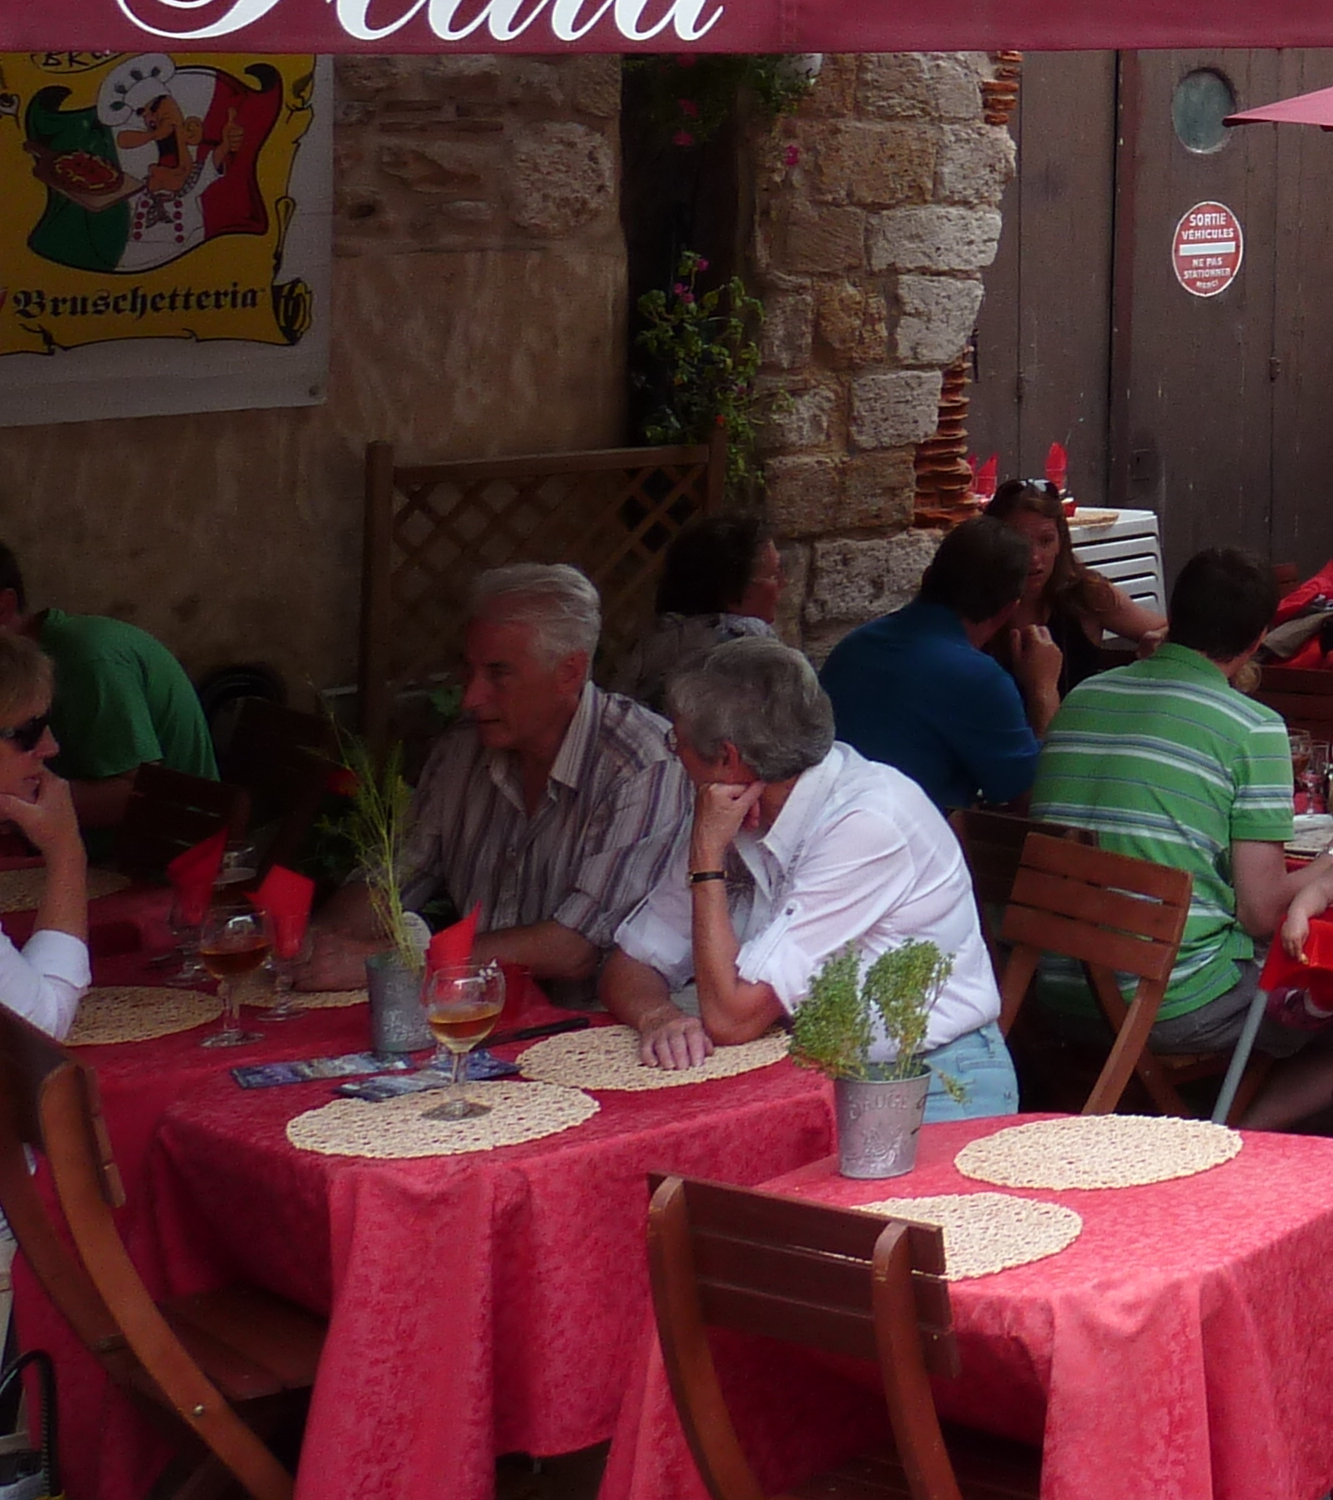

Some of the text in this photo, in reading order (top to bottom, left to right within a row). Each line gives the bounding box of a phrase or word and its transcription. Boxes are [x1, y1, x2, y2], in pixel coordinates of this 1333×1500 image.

[1189, 212, 1227, 227] SORTIE
[1181, 228, 1234, 241] VÉHICULES
[1192, 257, 1223, 268] NE PAS
[13, 282, 259, 319] Bruschetteria
